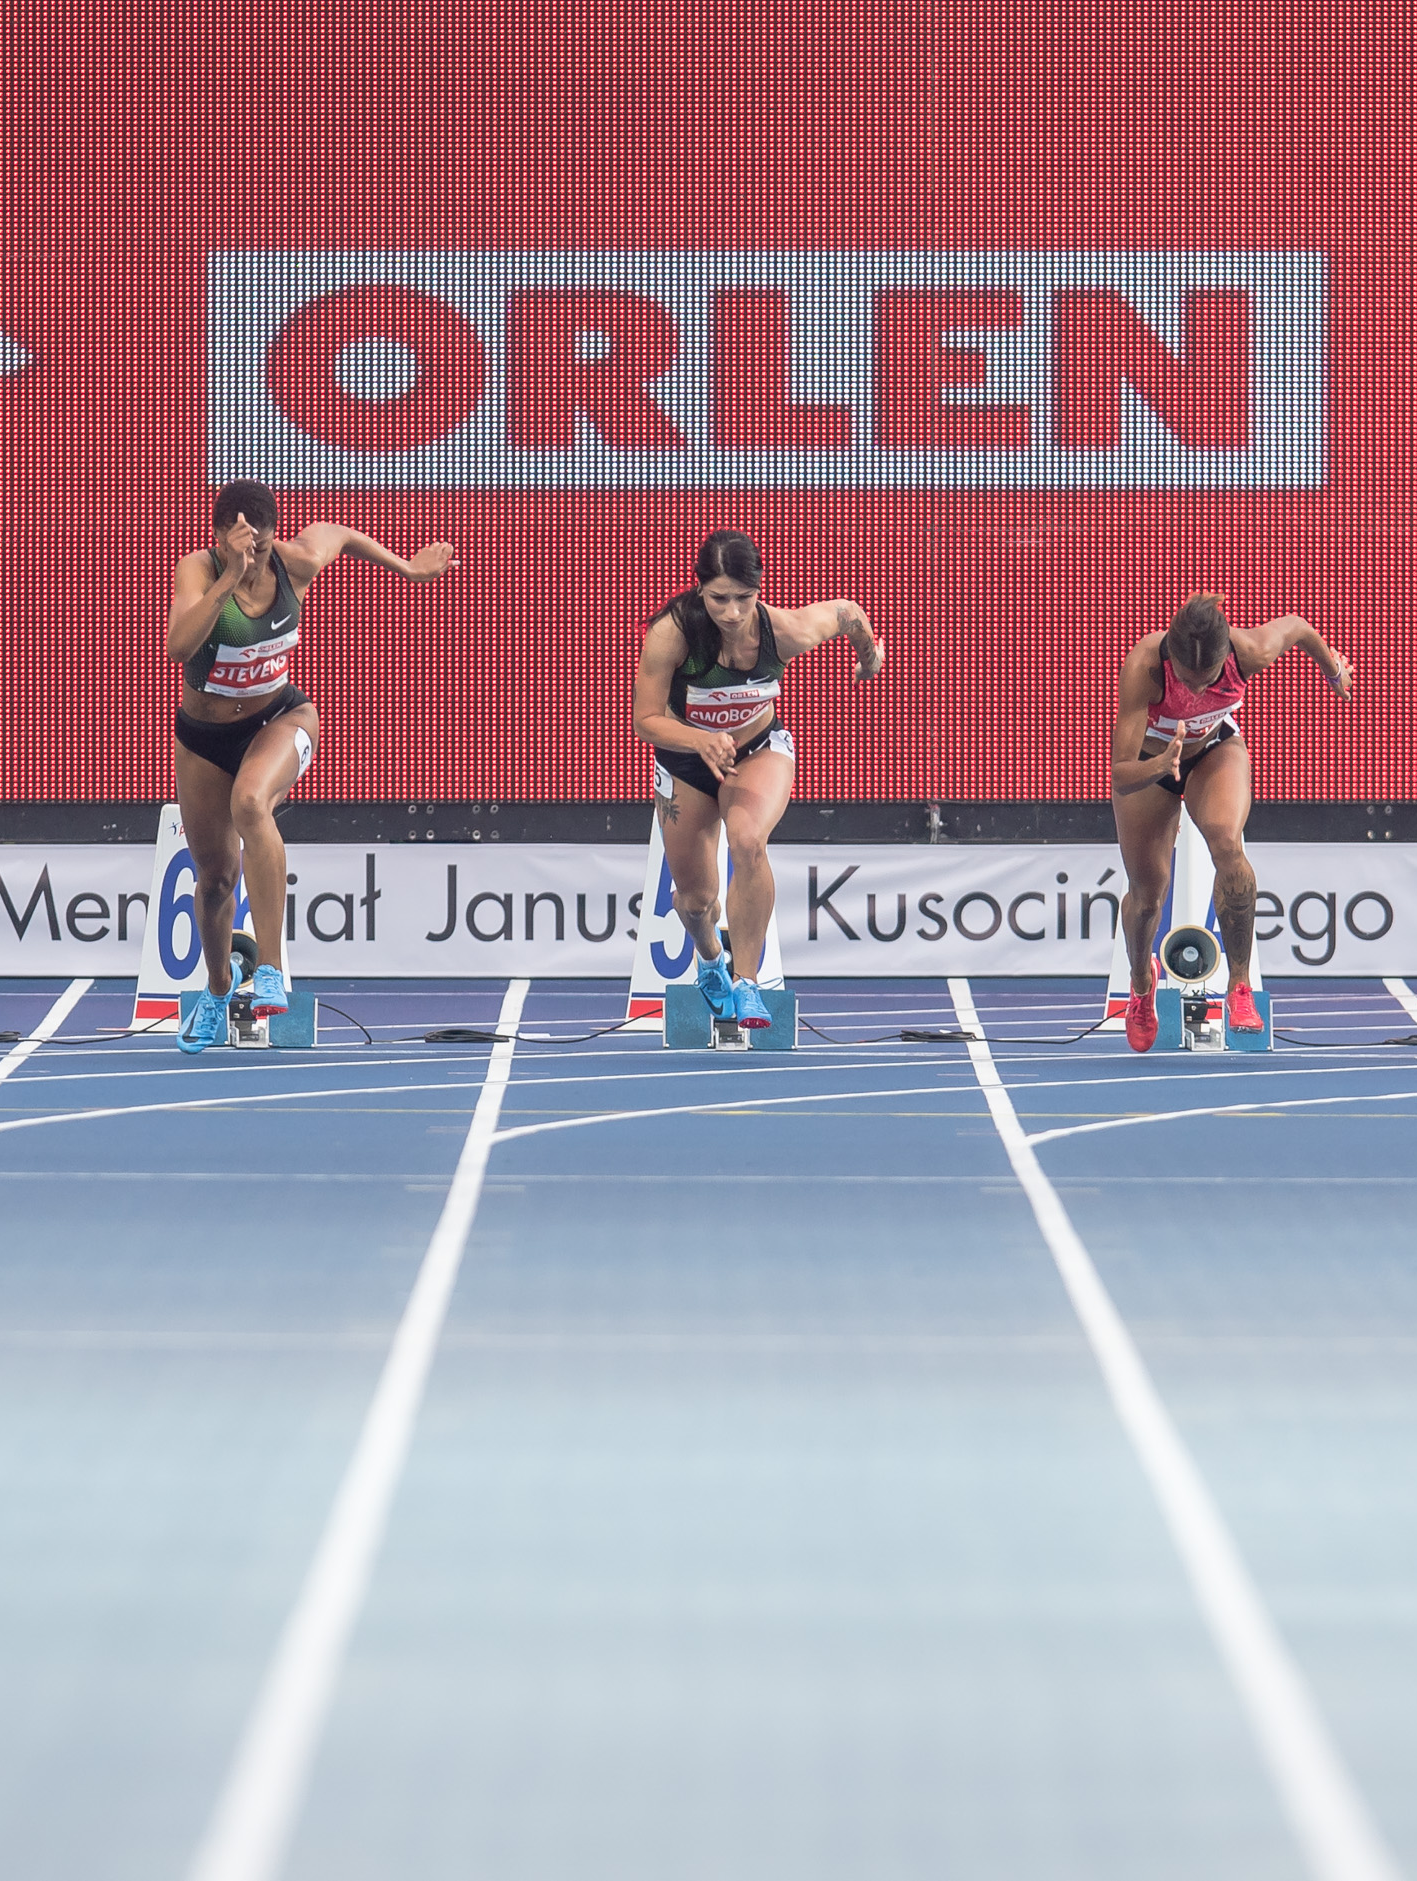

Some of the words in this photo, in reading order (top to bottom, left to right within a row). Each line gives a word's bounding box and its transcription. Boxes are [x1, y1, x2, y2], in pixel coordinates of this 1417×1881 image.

[265, 283, 1249, 455] ORLEN
[213, 654, 287, 683] STEVENS
[731, 690, 759, 699] ORLEN
[301, 745, 310, 764] 6
[158, 847, 203, 981] 6
[425, 864, 644, 943] Janus
[807, 865, 1394, 966] Kusocińego
